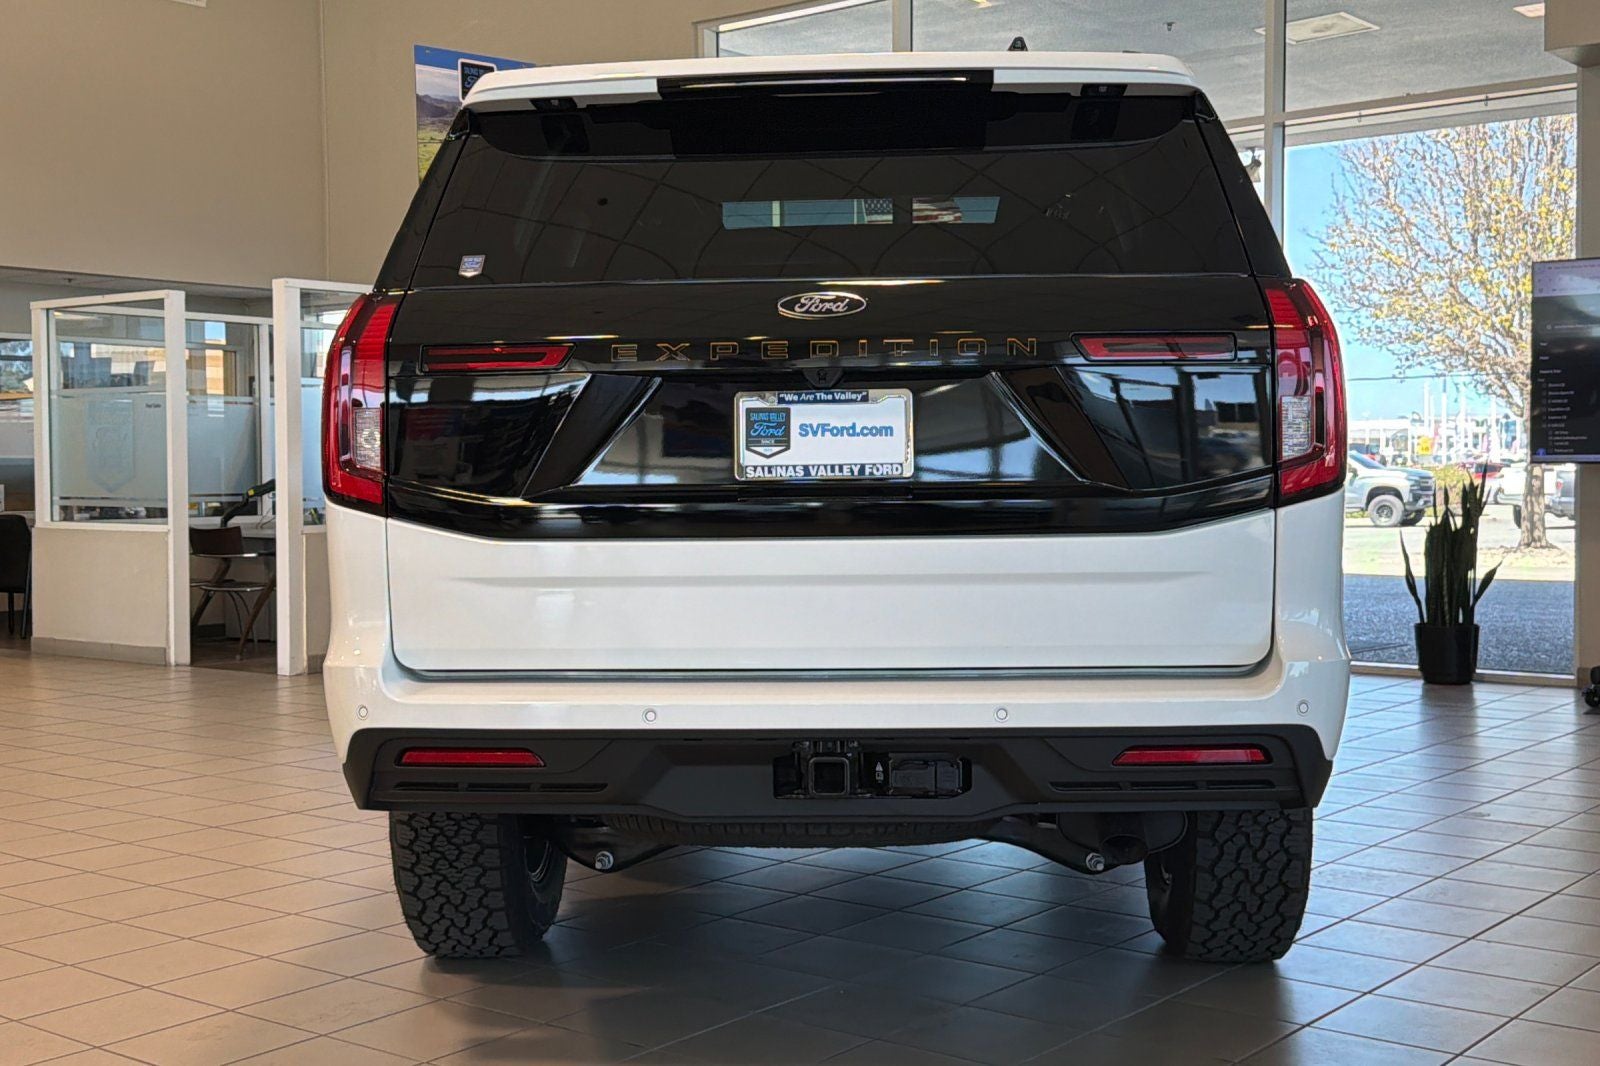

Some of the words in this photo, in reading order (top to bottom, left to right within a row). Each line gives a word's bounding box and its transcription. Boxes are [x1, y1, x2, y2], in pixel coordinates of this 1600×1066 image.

[795, 294, 848, 312] Ford
[610, 337, 1038, 362] EXPEDITION
[799, 393, 814, 401] Are
[815, 392, 832, 401] The
[750, 421, 785, 436] Ford
[798, 422, 894, 437] SVFord.com
[745, 465, 805, 478] SALINAS
[806, 464, 861, 477] VALLEY
[864, 463, 903, 476] FORD
